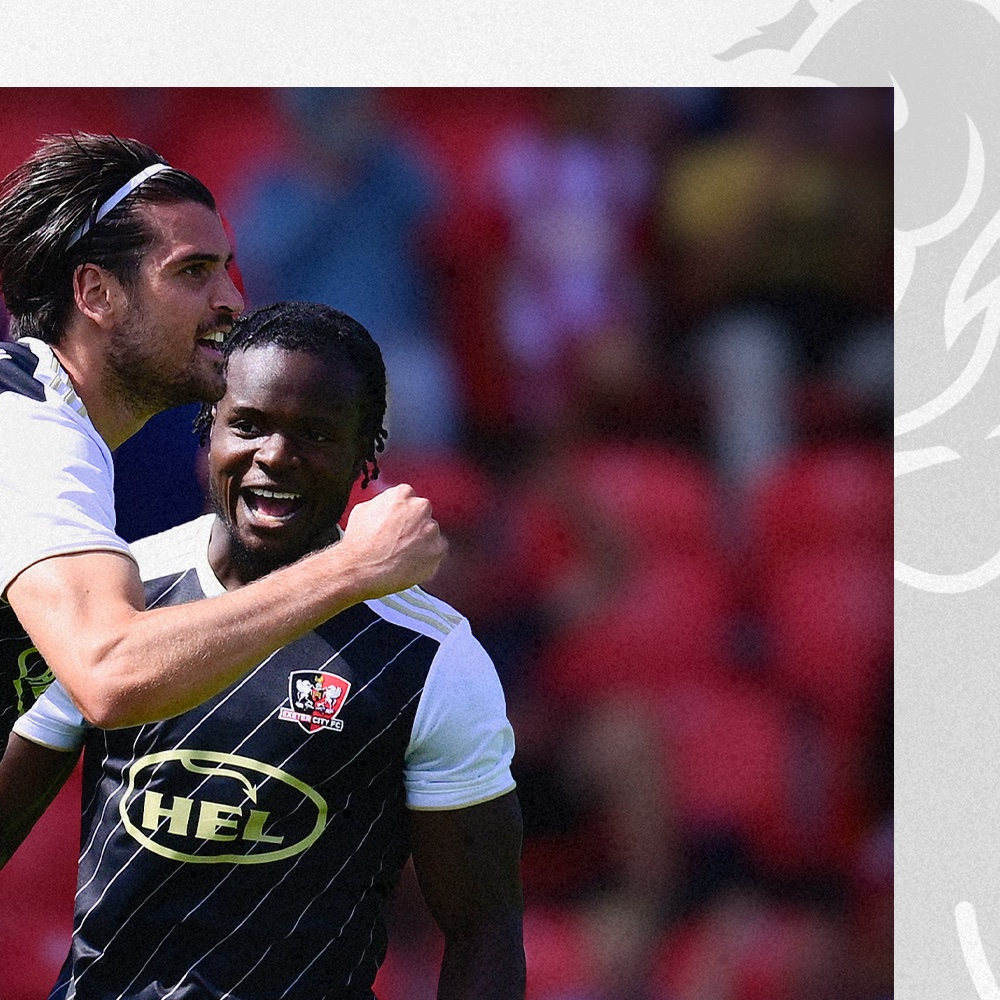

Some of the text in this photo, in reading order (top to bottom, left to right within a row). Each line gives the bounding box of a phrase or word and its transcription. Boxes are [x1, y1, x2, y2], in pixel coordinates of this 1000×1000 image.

[282, 710, 341, 729] EXETER CITY FC
[142, 790, 285, 844] HEL
